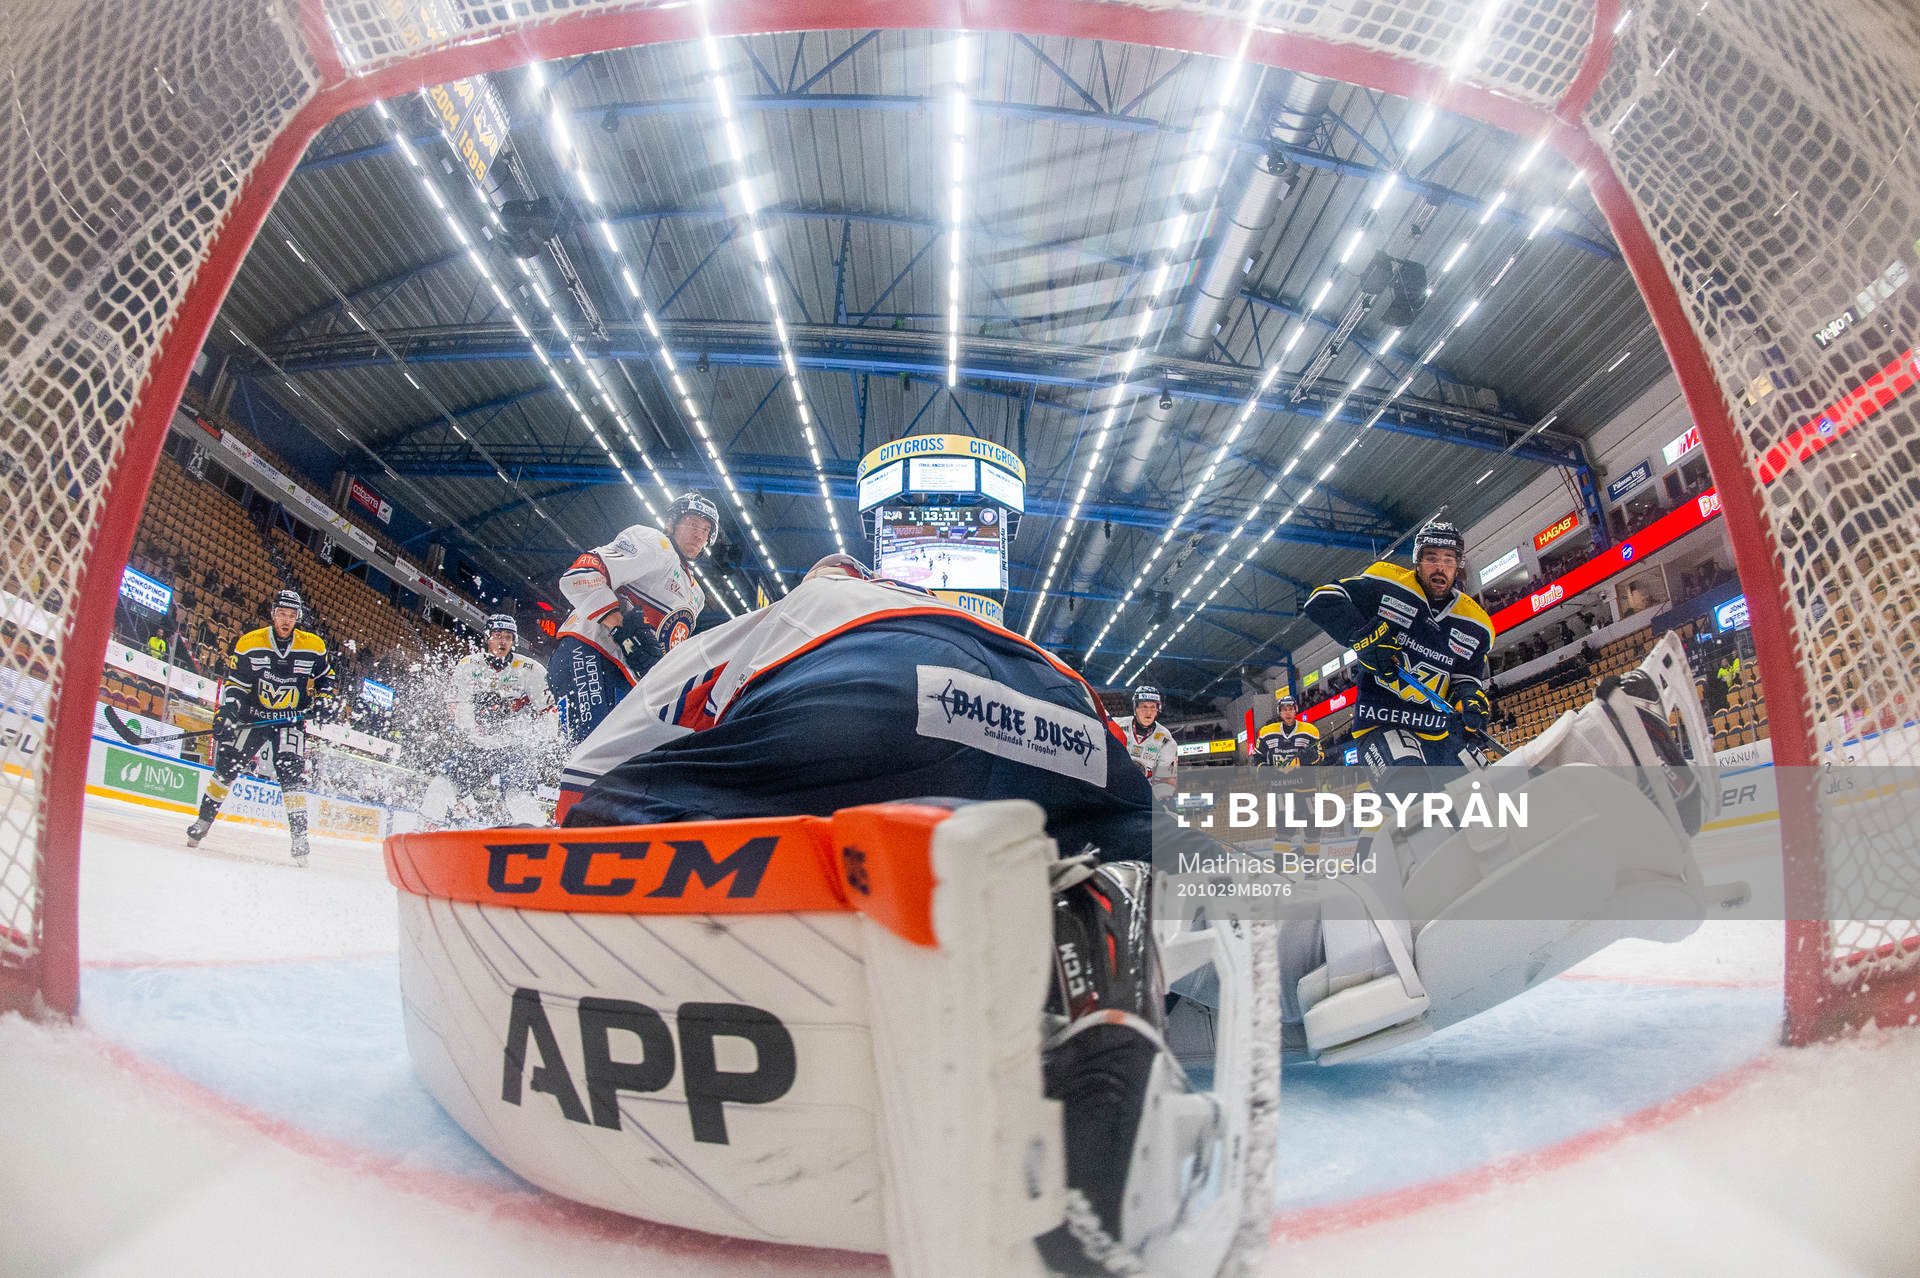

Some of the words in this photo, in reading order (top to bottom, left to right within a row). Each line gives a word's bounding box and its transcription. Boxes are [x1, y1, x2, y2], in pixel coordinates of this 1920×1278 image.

[430, 84, 460, 133] 2004
[458, 129, 486, 181] 1995
[880, 442, 903, 461] CITY
[904, 437, 945, 454] GROSS
[970, 440, 995, 458] CITY
[995, 448, 1020, 473] GROSS
[908, 511, 917, 521] 1
[924, 511, 958, 521] 13:11
[965, 511, 973, 521] 1
[1698, 492, 1721, 517] Du
[1423, 536, 1457, 546] Passera
[1539, 518, 1571, 545] HAGAB
[958, 595, 985, 614] CITY
[1531, 584, 1564, 612] Dumle
[1353, 621, 1390, 651] BAUER
[1405, 637, 1454, 666] Husqvarna
[572, 645, 593, 722] WELLNESS
[585, 655, 603, 706] NORDIC
[983, 726, 1024, 747] Småländsk
[1026, 739, 1057, 758] Trygghet
[1033, 715, 1086, 755] BUSS
[144, 764, 185, 789] INVID
[244, 783, 283, 807] STENA
[483, 836, 782, 899] CCM
[1058, 942, 1086, 998] CCM
[501, 987, 797, 1146] APP
